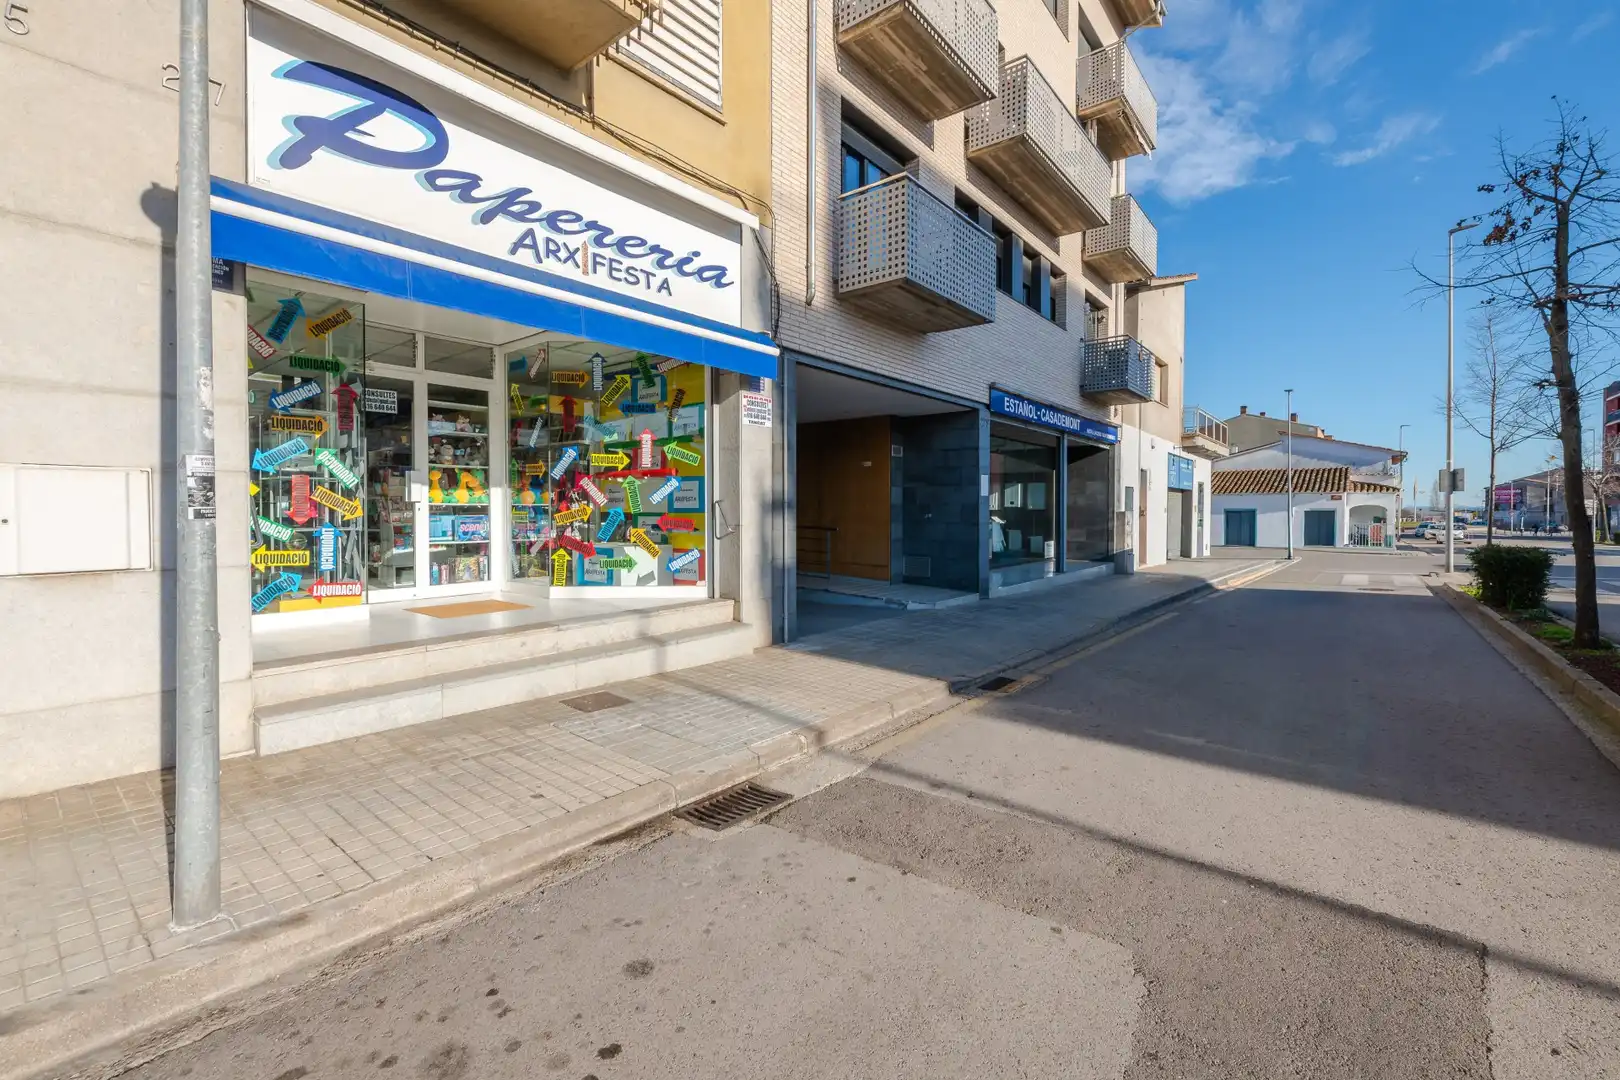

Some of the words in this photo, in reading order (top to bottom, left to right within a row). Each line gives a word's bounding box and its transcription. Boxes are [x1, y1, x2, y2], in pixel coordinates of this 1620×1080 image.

[266, 59, 735, 289] Papereria
[309, 308, 353, 338] LIQUIDACIÓ
[289, 355, 340, 373] LIQUIDACIÓ
[271, 381, 322, 409] LIQUIDACIÓ
[601, 375, 629, 407] LIQUIDACIÓ
[271, 416, 324, 432] LIQUIDACIÓ
[256, 439, 306, 469] LIQUIDACIÓ
[550, 446, 578, 481] LIQUIDACIÓ
[591, 454, 625, 467] LIQUIDACIÓ
[666, 445, 700, 465] LIQUIDACIÓ
[313, 487, 360, 517] LIQUIDACIÓ
[649, 477, 679, 505] LIQUIDACIÓ
[554, 507, 589, 524] LIQUIDACIÓ
[321, 527, 336, 571] LIQUIDACIÓ
[631, 529, 661, 560] LIQUIDACIÓ
[254, 552, 309, 566] LIQUIDACIÓ
[599, 557, 634, 569] LIQUIDACIÓ
[669, 548, 700, 572] LIQUIDACIÓ
[312, 582, 362, 597] LIQUIDACIÓ
